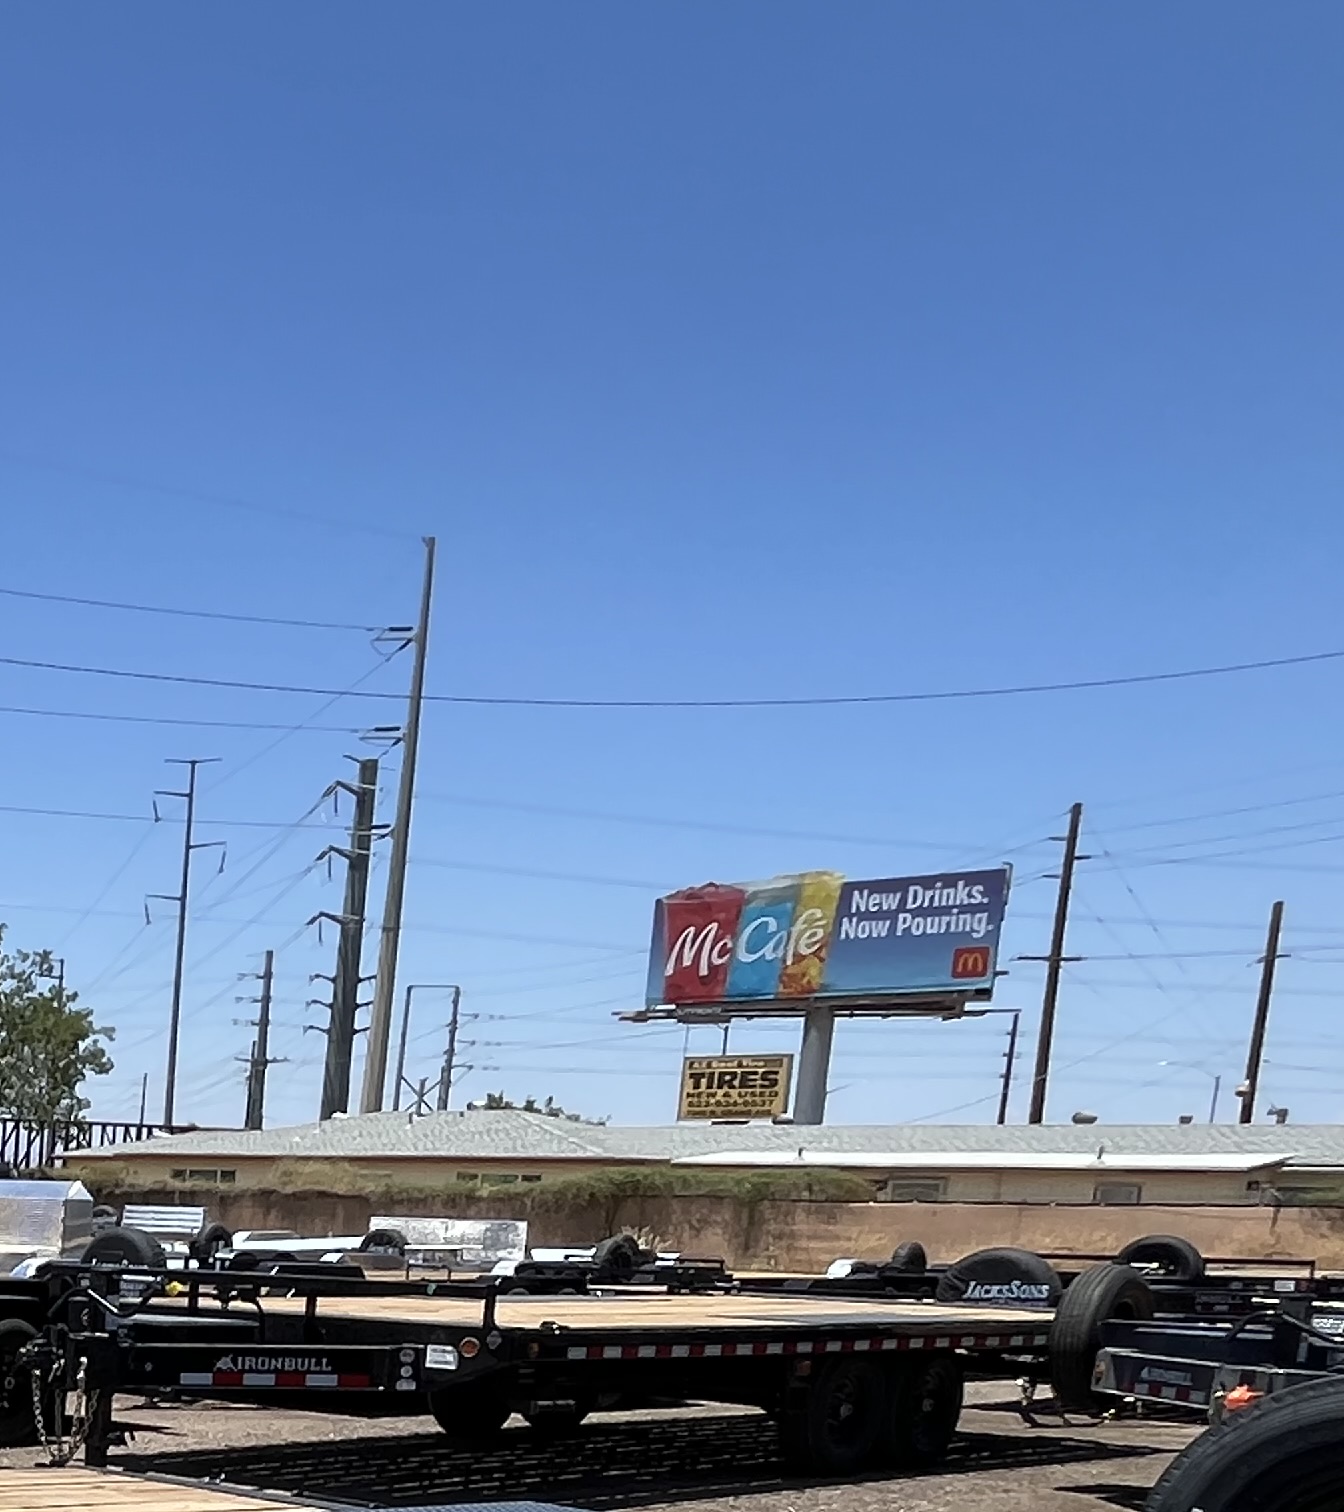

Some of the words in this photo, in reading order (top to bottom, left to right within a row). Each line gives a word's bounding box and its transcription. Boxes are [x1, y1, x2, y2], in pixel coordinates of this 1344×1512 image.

[851, 889, 901, 913] New
[906, 880, 989, 909] Drinks.
[839, 917, 891, 940] Now
[896, 909, 995, 938] Pouring.
[688, 1071, 780, 1089] TIRES
[737, 1090, 779, 1098] USED
[237, 1356, 332, 1371] IRONBULL
